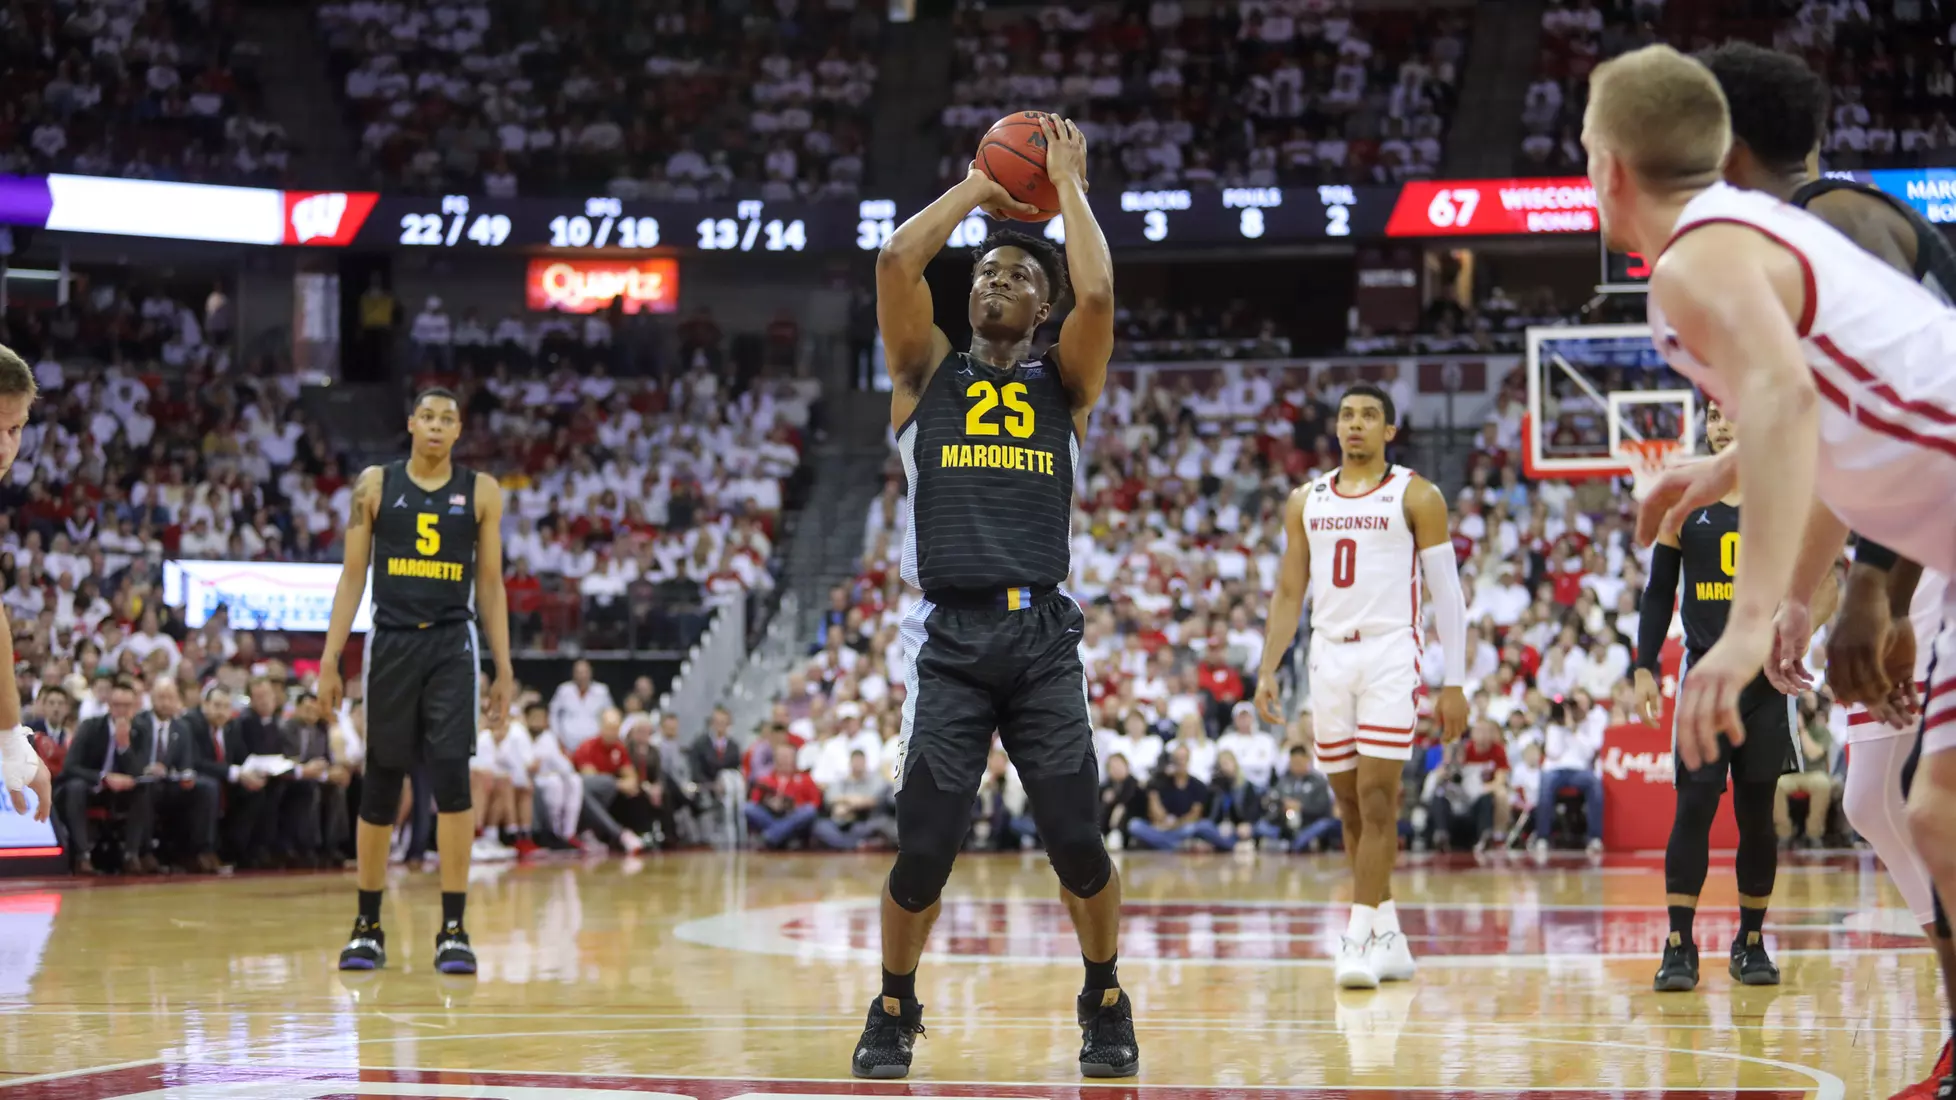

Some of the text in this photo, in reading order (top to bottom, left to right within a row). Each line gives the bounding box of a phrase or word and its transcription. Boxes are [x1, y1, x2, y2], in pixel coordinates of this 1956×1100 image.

[1121, 190, 1191, 211] BLOCKS
[1223, 187, 1281, 207] FOULS
[1428, 189, 1479, 227] 67
[1144, 210, 1168, 241] 3
[1241, 207, 1264, 238] 8
[1326, 204, 1350, 236] 2
[1527, 210, 1593, 232] BONUS
[965, 380, 1034, 438] 25
[941, 444, 1053, 476] MARQUETTE
[416, 512, 440, 556] 5
[1309, 516, 1389, 531] WISCONSIN
[388, 557, 463, 581] MARQUETTE
[1332, 538, 1357, 588] 0
[1720, 531, 1741, 576] 0
